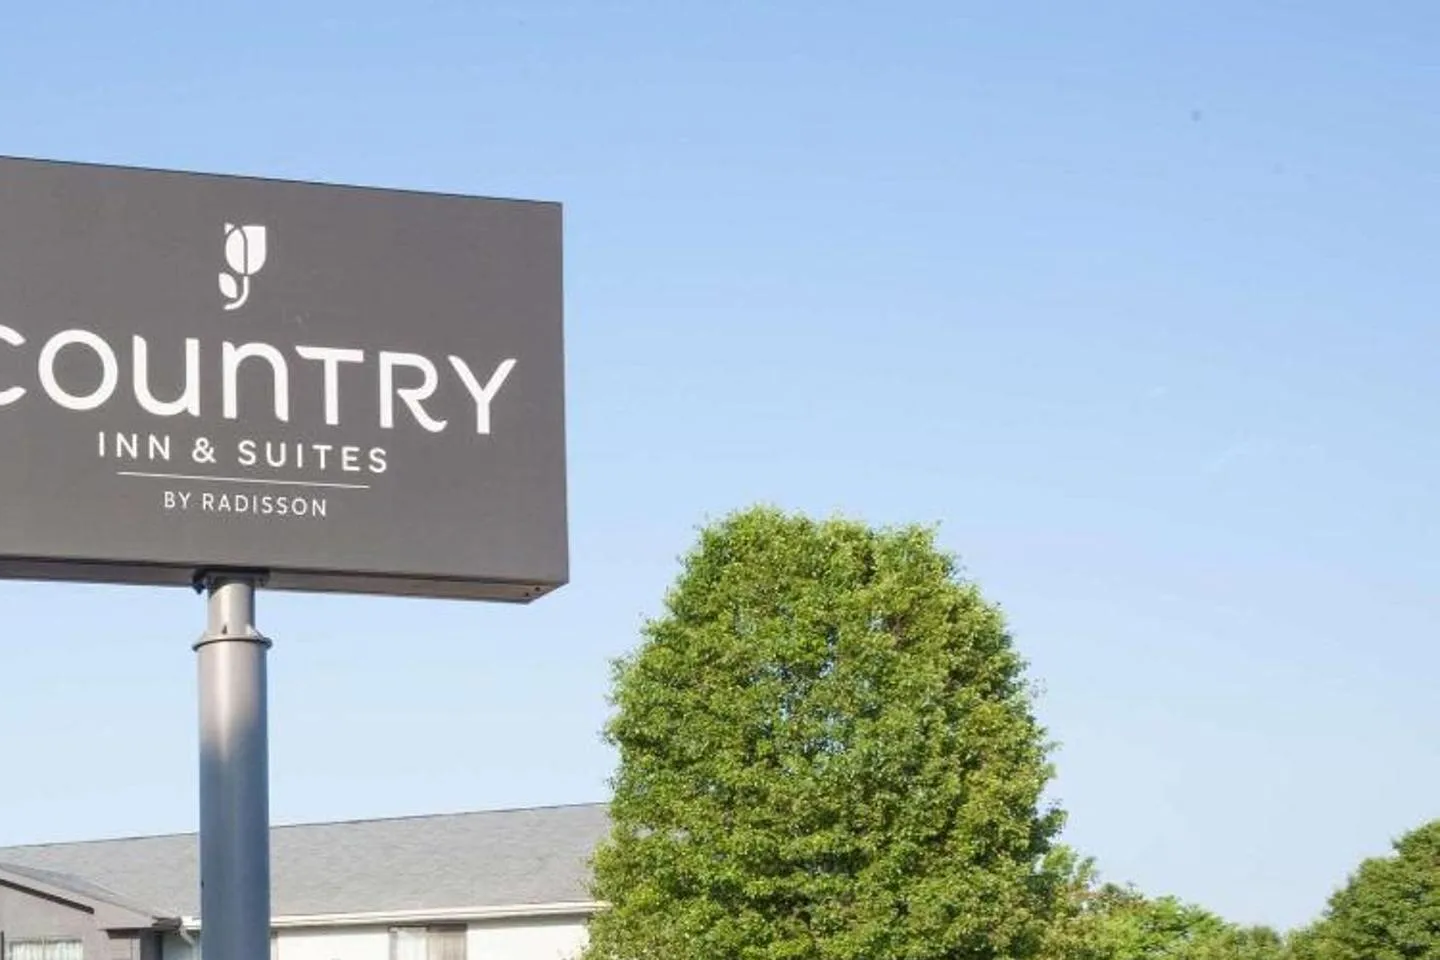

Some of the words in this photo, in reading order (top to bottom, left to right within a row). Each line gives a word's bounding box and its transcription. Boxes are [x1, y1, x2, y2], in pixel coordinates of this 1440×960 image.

[97, 430, 171, 461] INN
[191, 436, 217, 464] &
[237, 439, 388, 474] SUITES
[163, 490, 192, 509] BY
[201, 492, 327, 517] RADISSON
